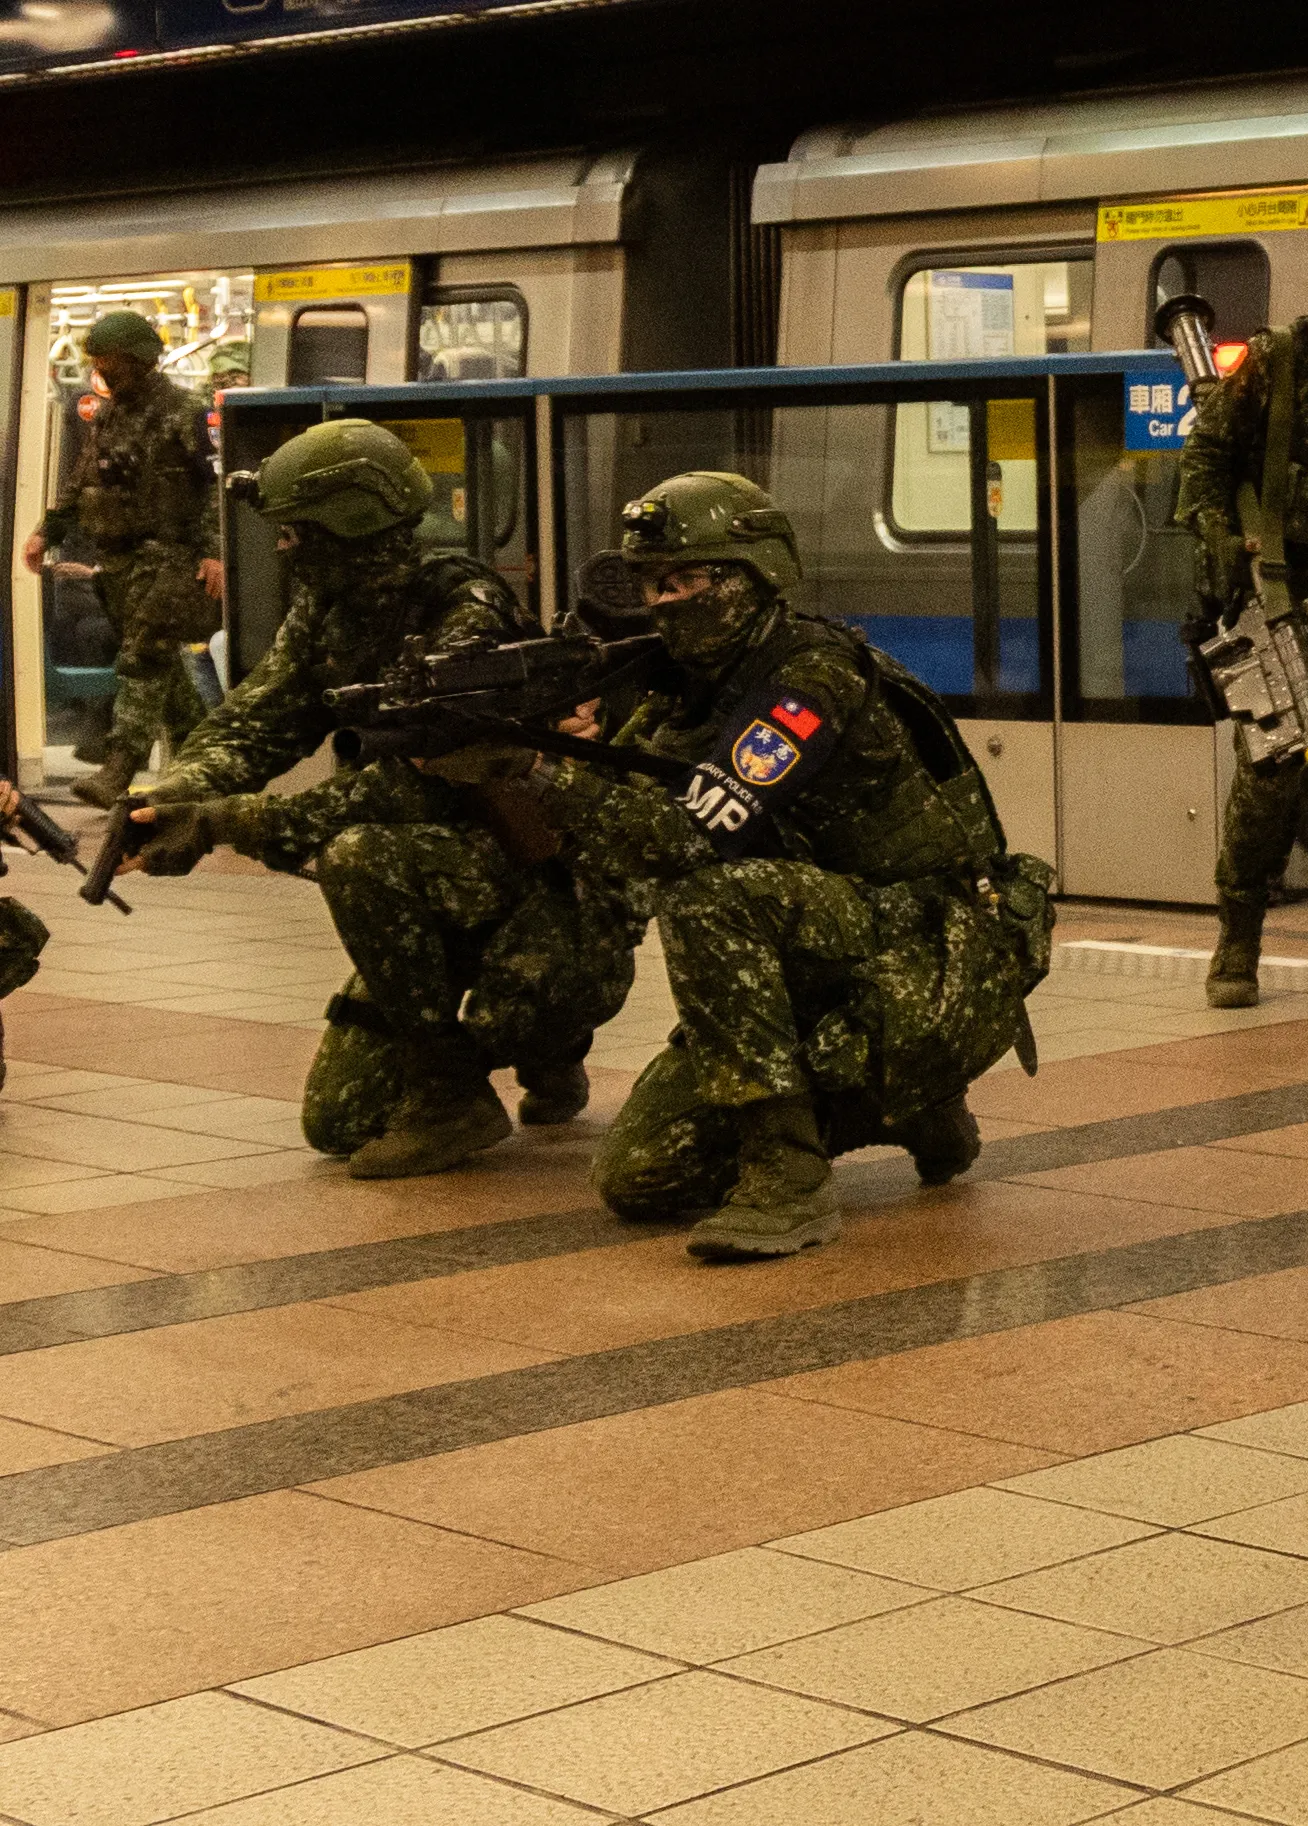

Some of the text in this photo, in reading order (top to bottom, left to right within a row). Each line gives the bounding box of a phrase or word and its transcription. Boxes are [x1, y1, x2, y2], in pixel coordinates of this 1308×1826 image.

[1129, 384, 1173, 414] 車廂
[1148, 419, 1174, 437] Car
[675, 774, 749, 832] MP
[723, 776, 753, 803] POLICE
